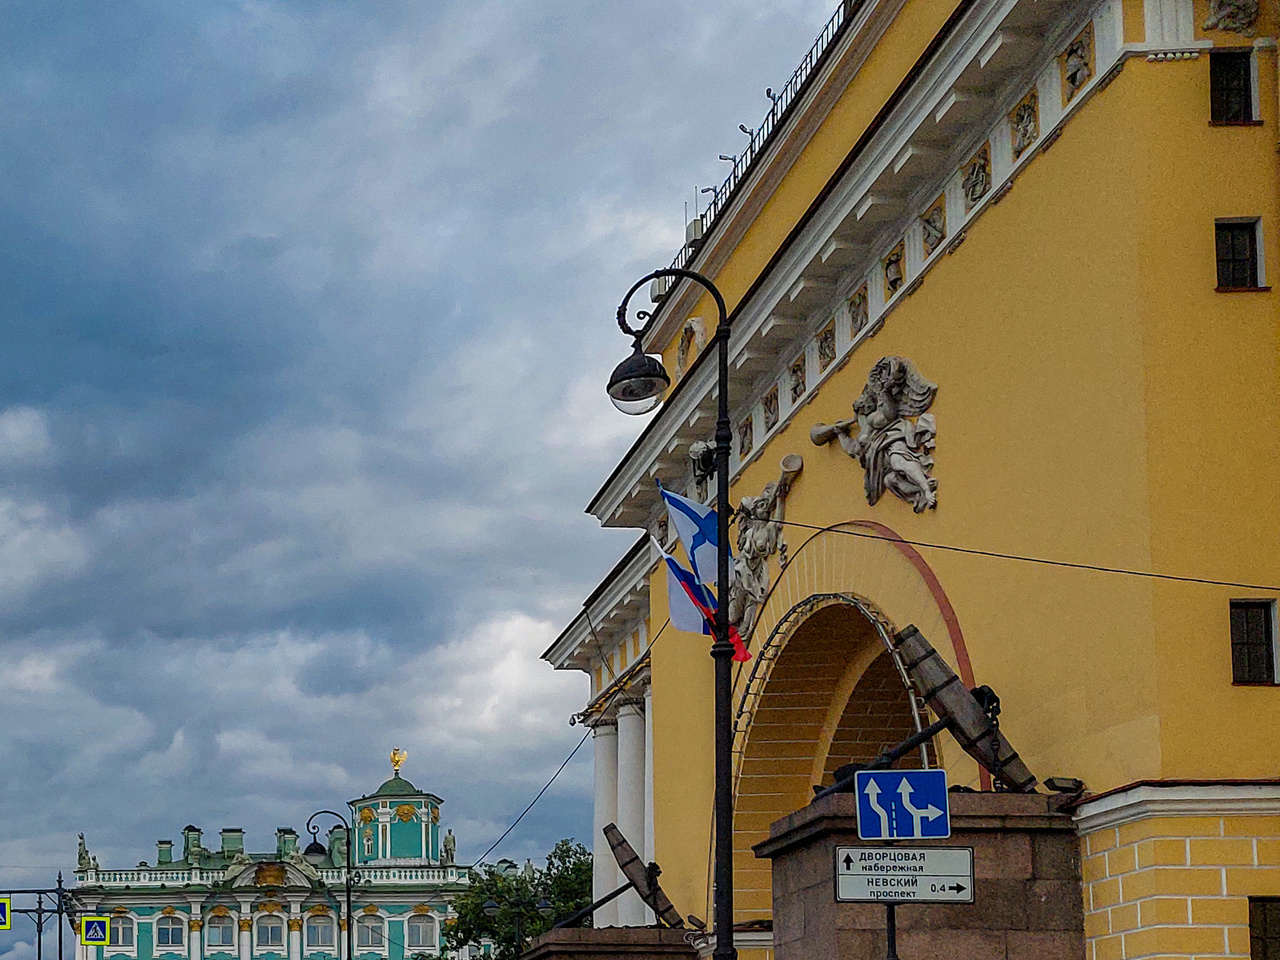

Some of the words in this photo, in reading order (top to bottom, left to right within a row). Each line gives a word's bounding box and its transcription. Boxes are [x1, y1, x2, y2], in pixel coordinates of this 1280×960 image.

[858, 852, 926, 863] ДВОРЦОВАЯ
[861, 863, 924, 874] набережная
[866, 875, 918, 888] НЕВСКИЙ
[869, 890, 917, 900] проспект
